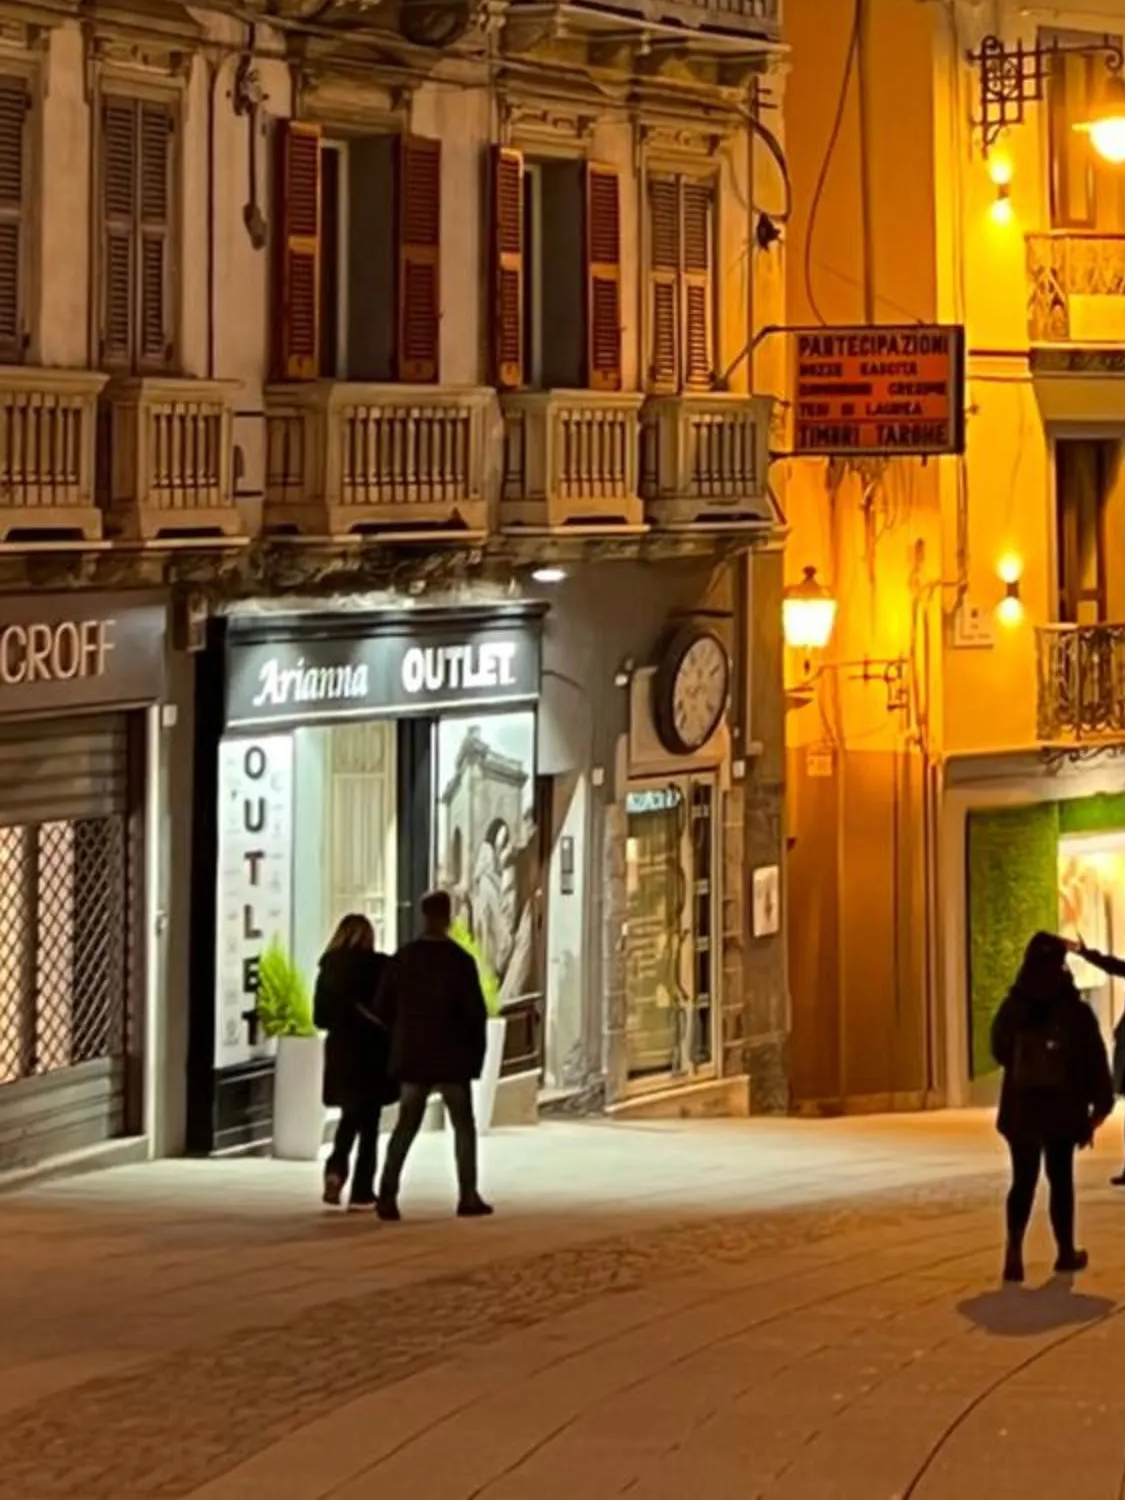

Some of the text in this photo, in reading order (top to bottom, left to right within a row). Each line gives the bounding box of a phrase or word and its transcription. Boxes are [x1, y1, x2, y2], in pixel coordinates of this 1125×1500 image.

[799, 334, 949, 357] PARTECIPAZIONI
[877, 423, 946, 448] TARGHE
[1, 619, 117, 684] CROFF
[253, 642, 517, 707] Arianna OUTLET
[242, 745, 267, 1046] OUTLET
